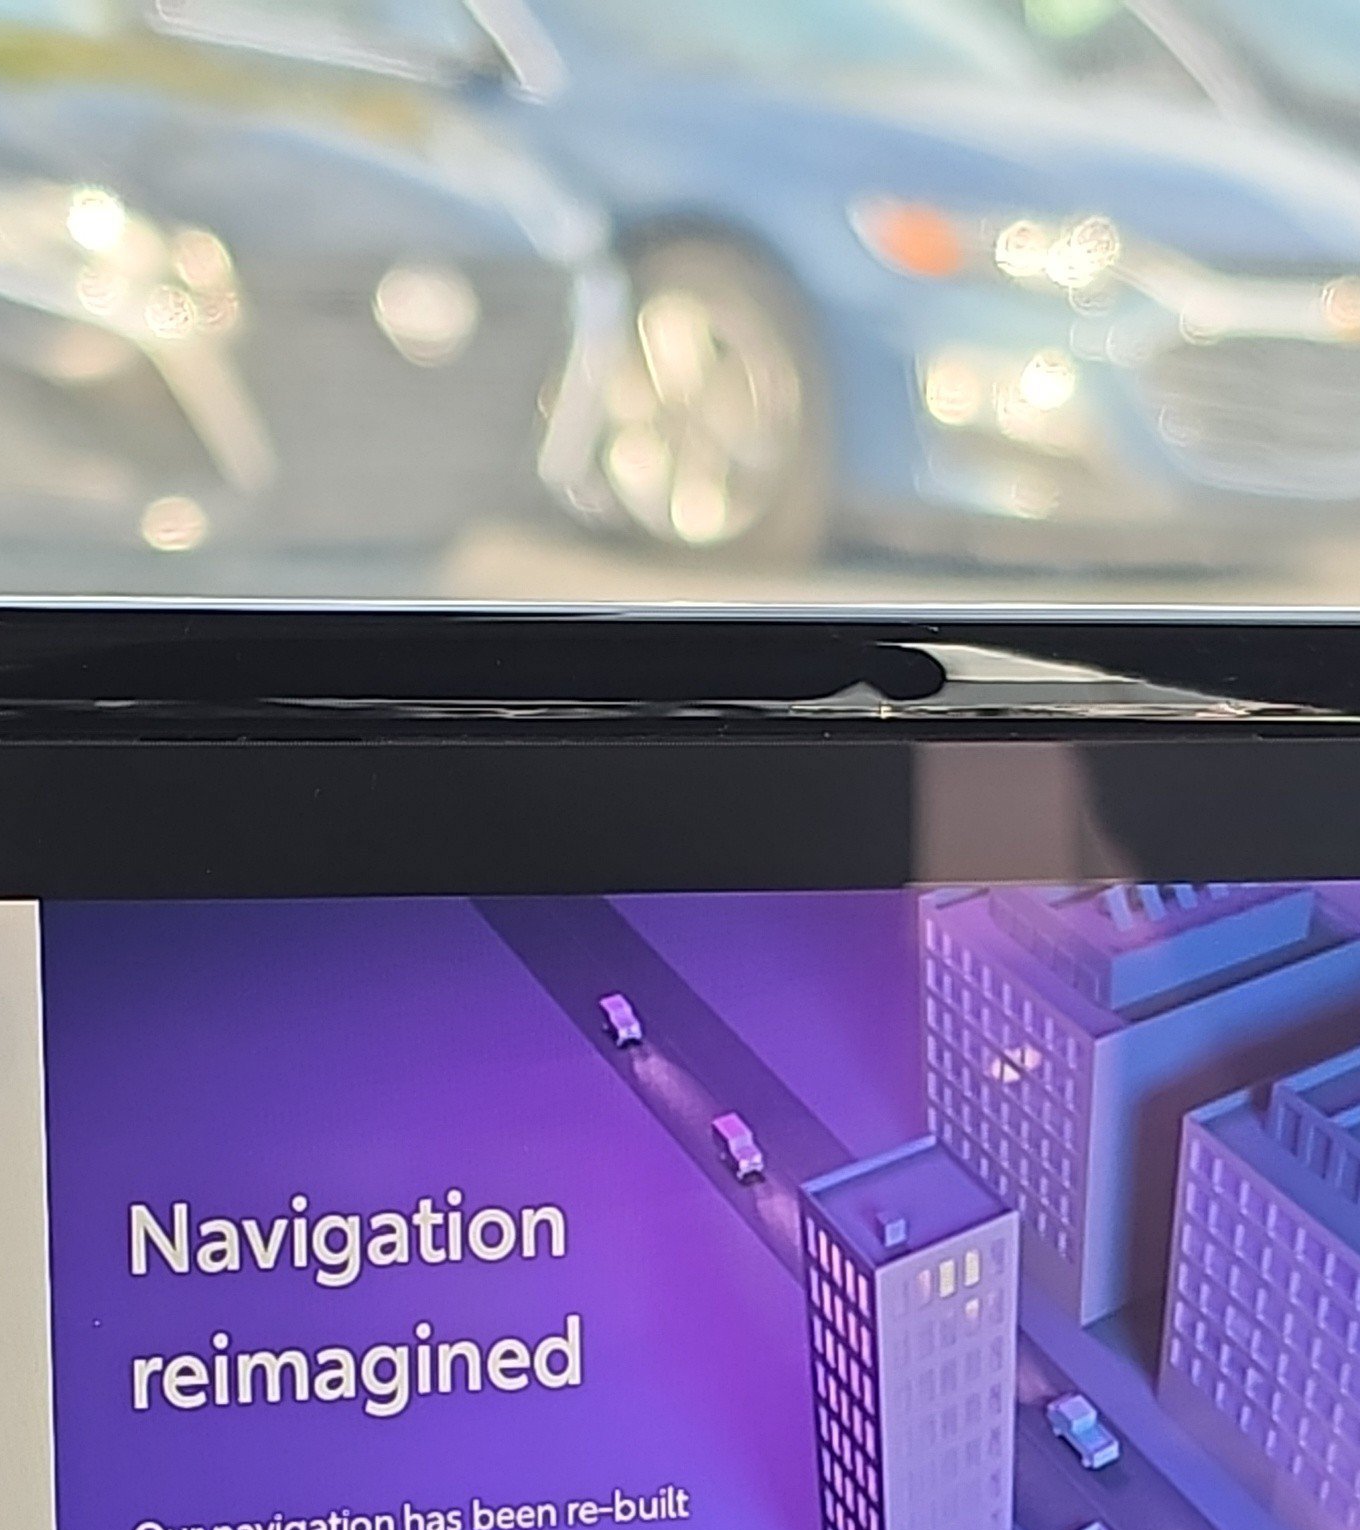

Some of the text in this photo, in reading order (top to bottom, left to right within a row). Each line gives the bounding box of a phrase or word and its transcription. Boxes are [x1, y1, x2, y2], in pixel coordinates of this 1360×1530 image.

[129, 1189, 567, 1287] Navigation
[132, 1314, 584, 1416] reimagined
[566, 1486, 690, 1526] re-built
